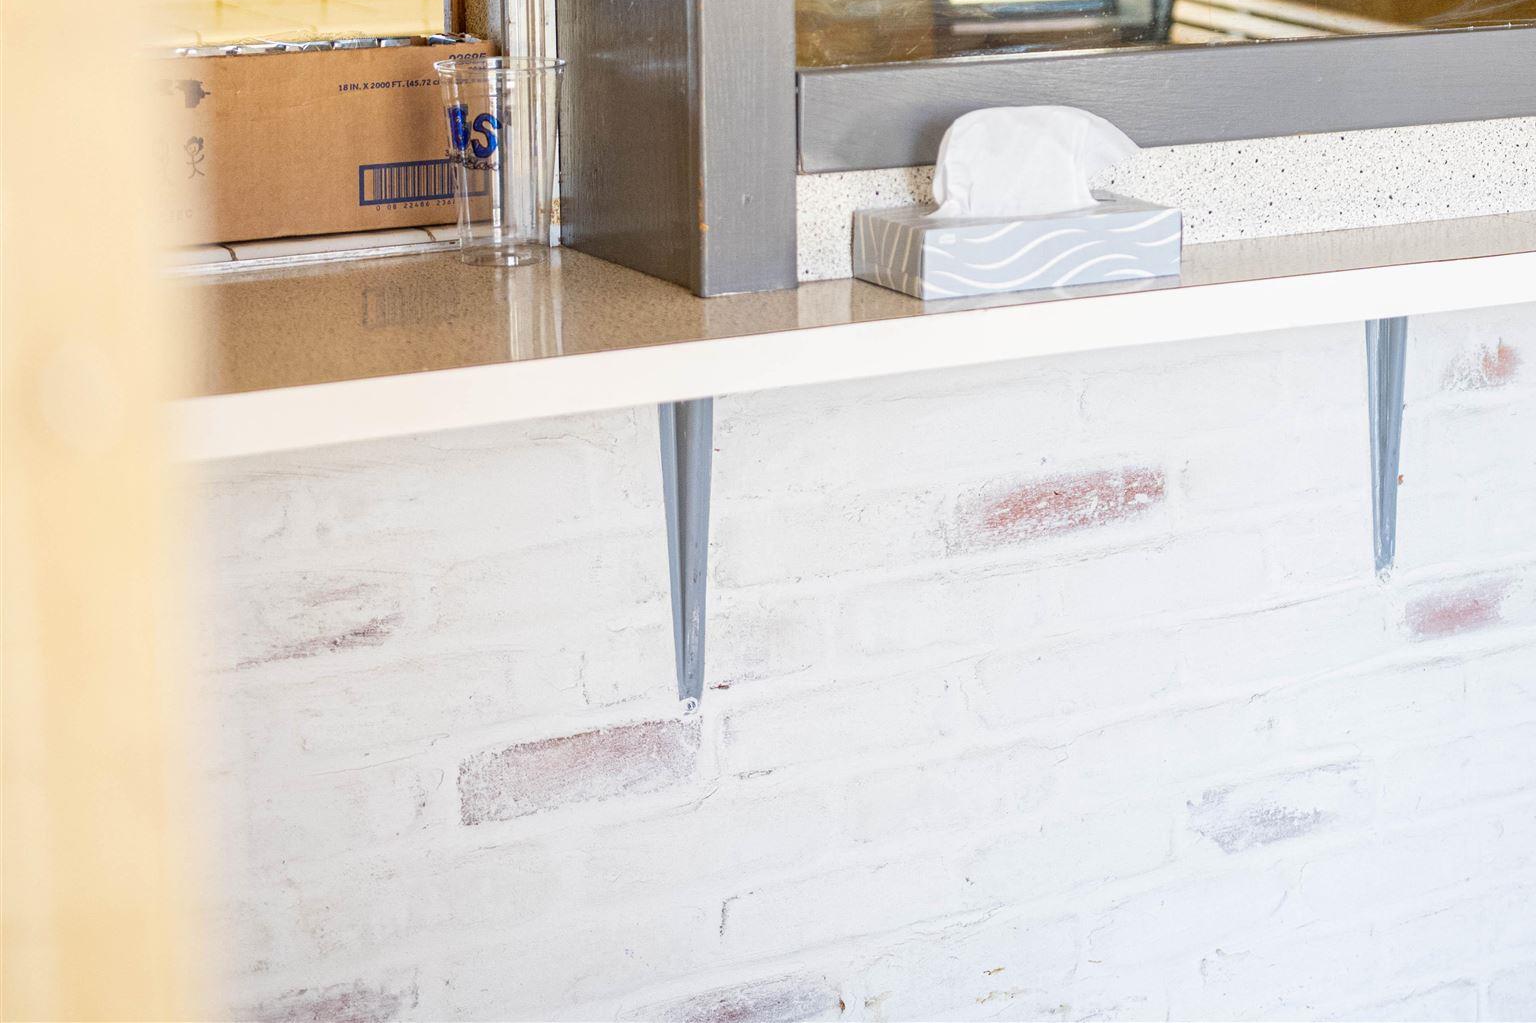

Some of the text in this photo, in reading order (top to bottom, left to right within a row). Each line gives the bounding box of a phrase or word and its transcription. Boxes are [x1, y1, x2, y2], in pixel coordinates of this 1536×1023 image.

[338, 84, 348, 92] 18
[370, 82, 390, 90] 2000
[392, 80, 405, 88] FT.
